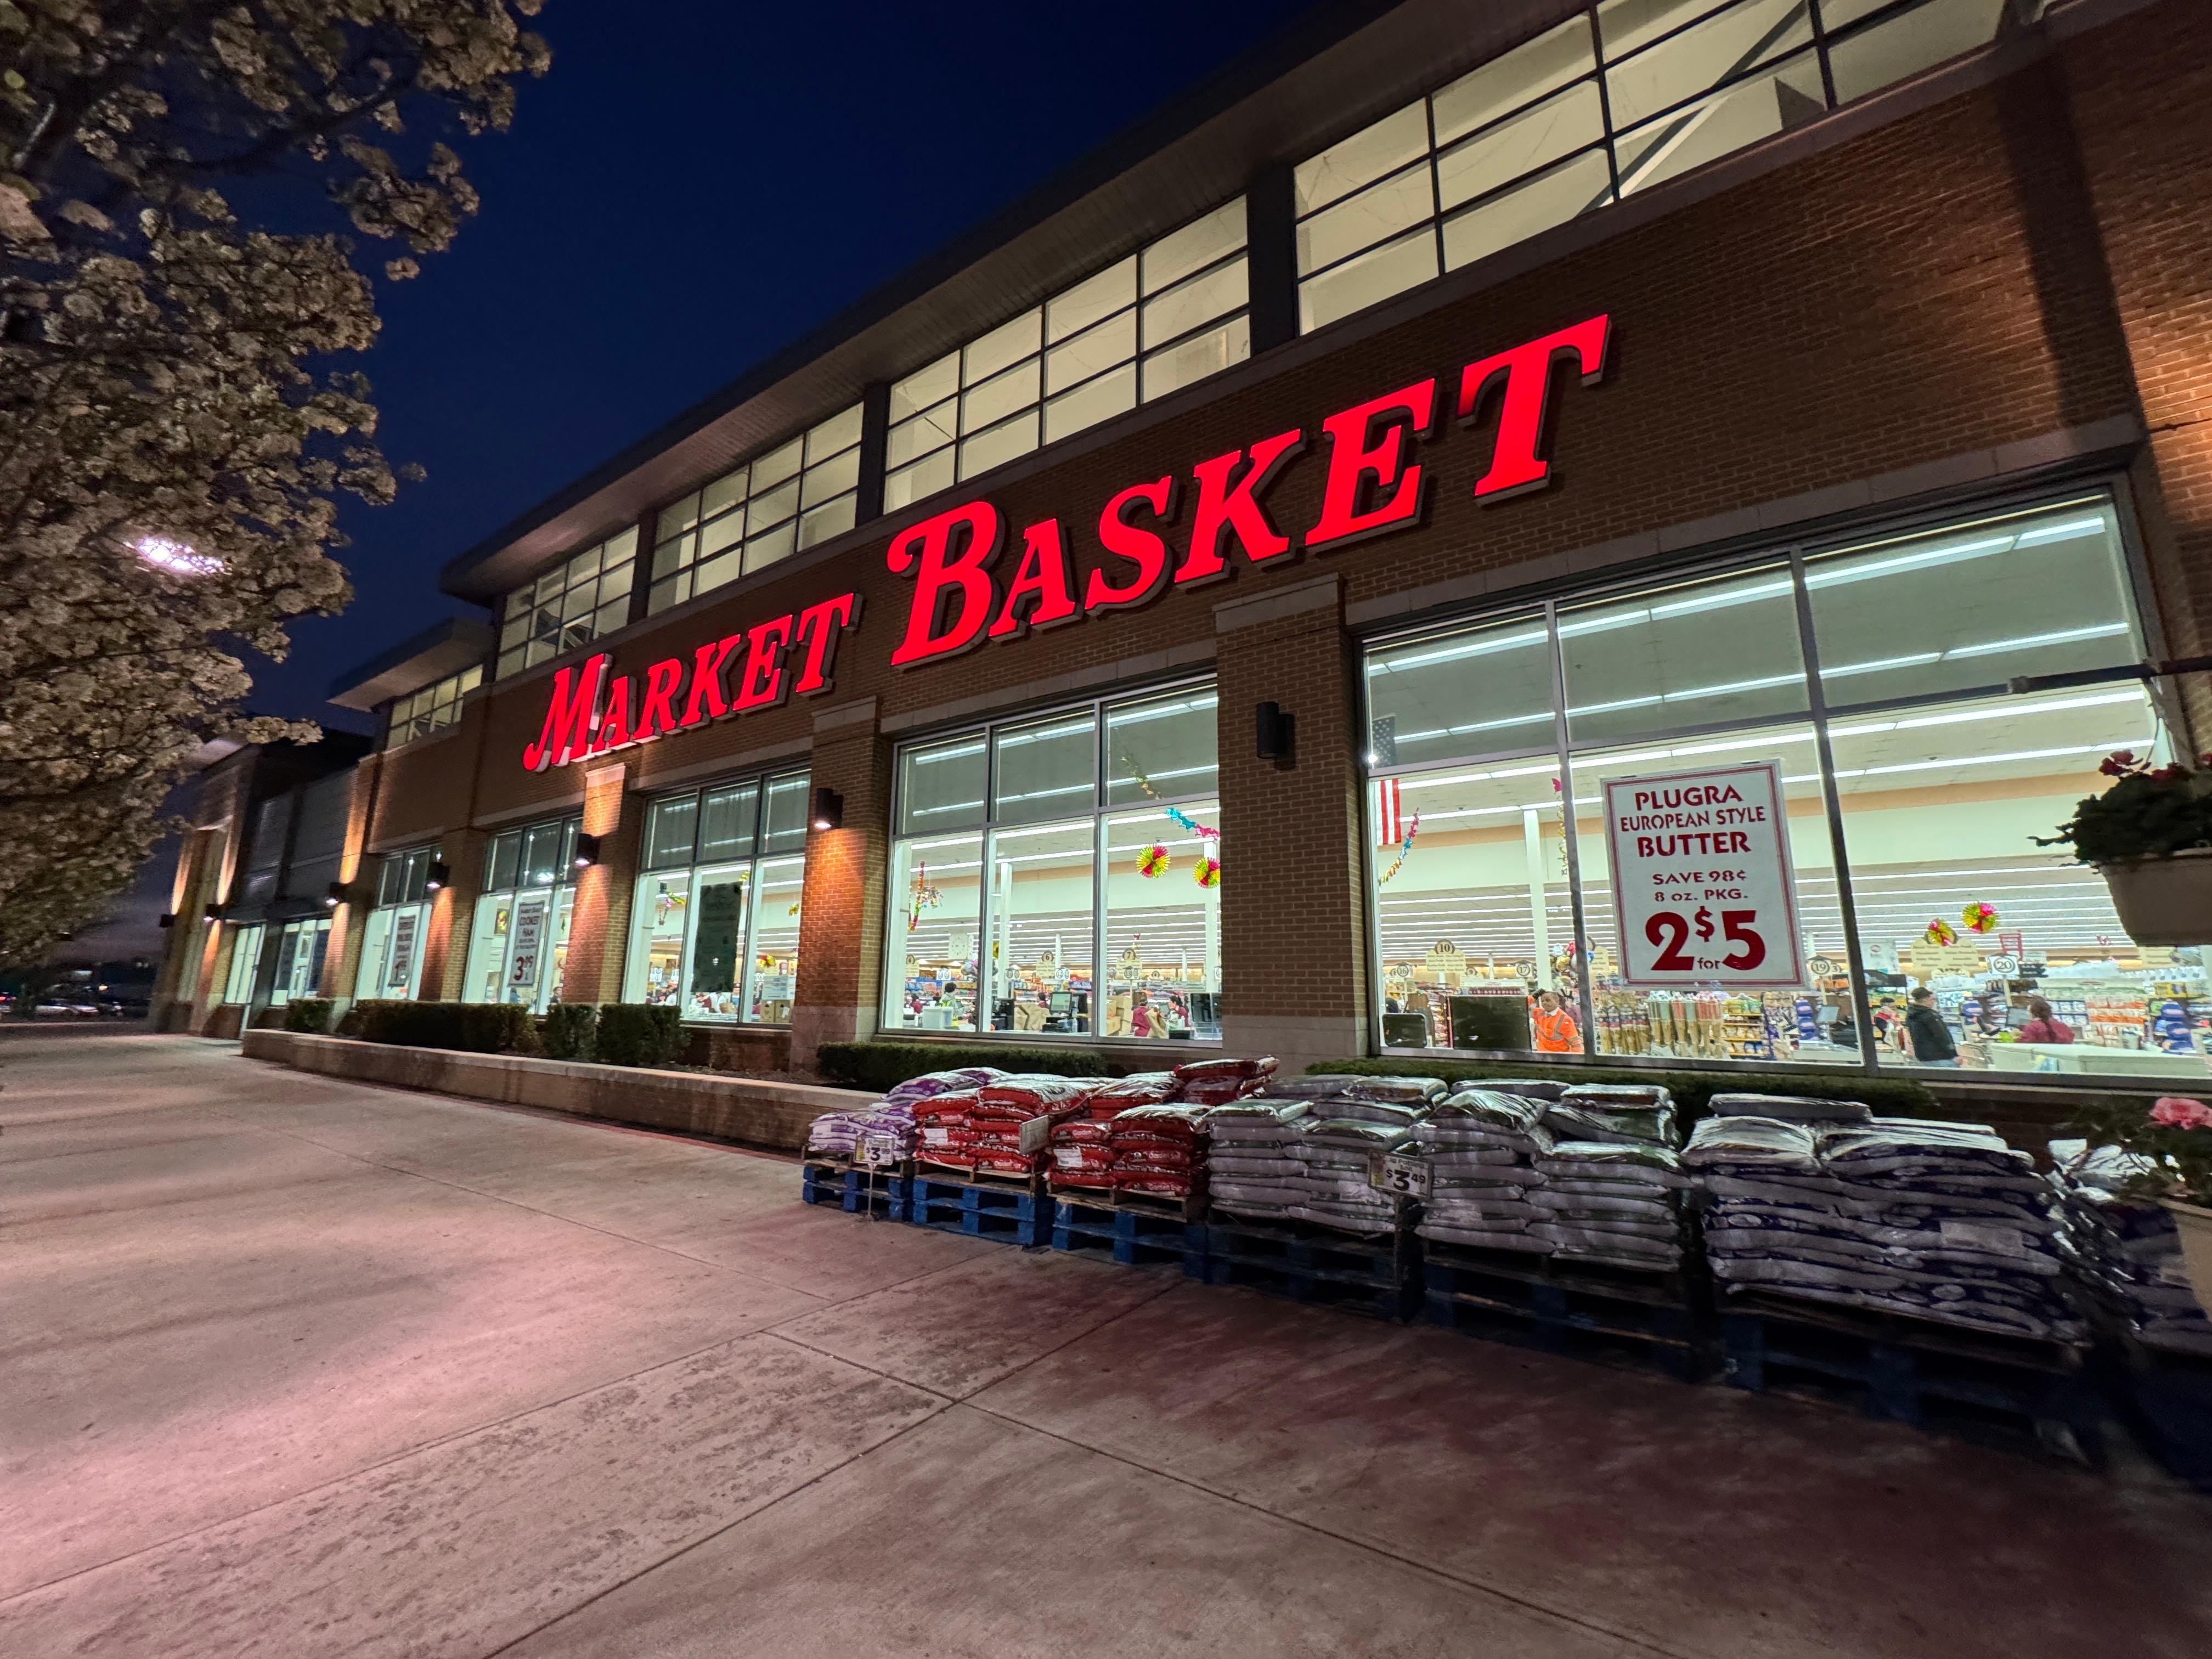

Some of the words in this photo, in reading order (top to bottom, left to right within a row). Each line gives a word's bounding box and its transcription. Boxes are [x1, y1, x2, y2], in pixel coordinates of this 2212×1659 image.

[1635, 785, 1743, 811] PLUGRA
[1620, 811, 1710, 832] EUROPEAN
[1716, 806, 1766, 825] STYLE
[1637, 831, 1752, 857] BUTTER
[1652, 872, 1705, 885] SAVE
[1709, 870, 1747, 883] 98¢
[1655, 891, 1664, 902] 8
[1705, 888, 1748, 900] PKG.
[1440, 943, 1451, 953] 10
[1645, 911, 1695, 971] 2
[1697, 957, 1721, 970] for
[1814, 963, 1826, 972] 19
[1996, 961, 2012, 969] 20
